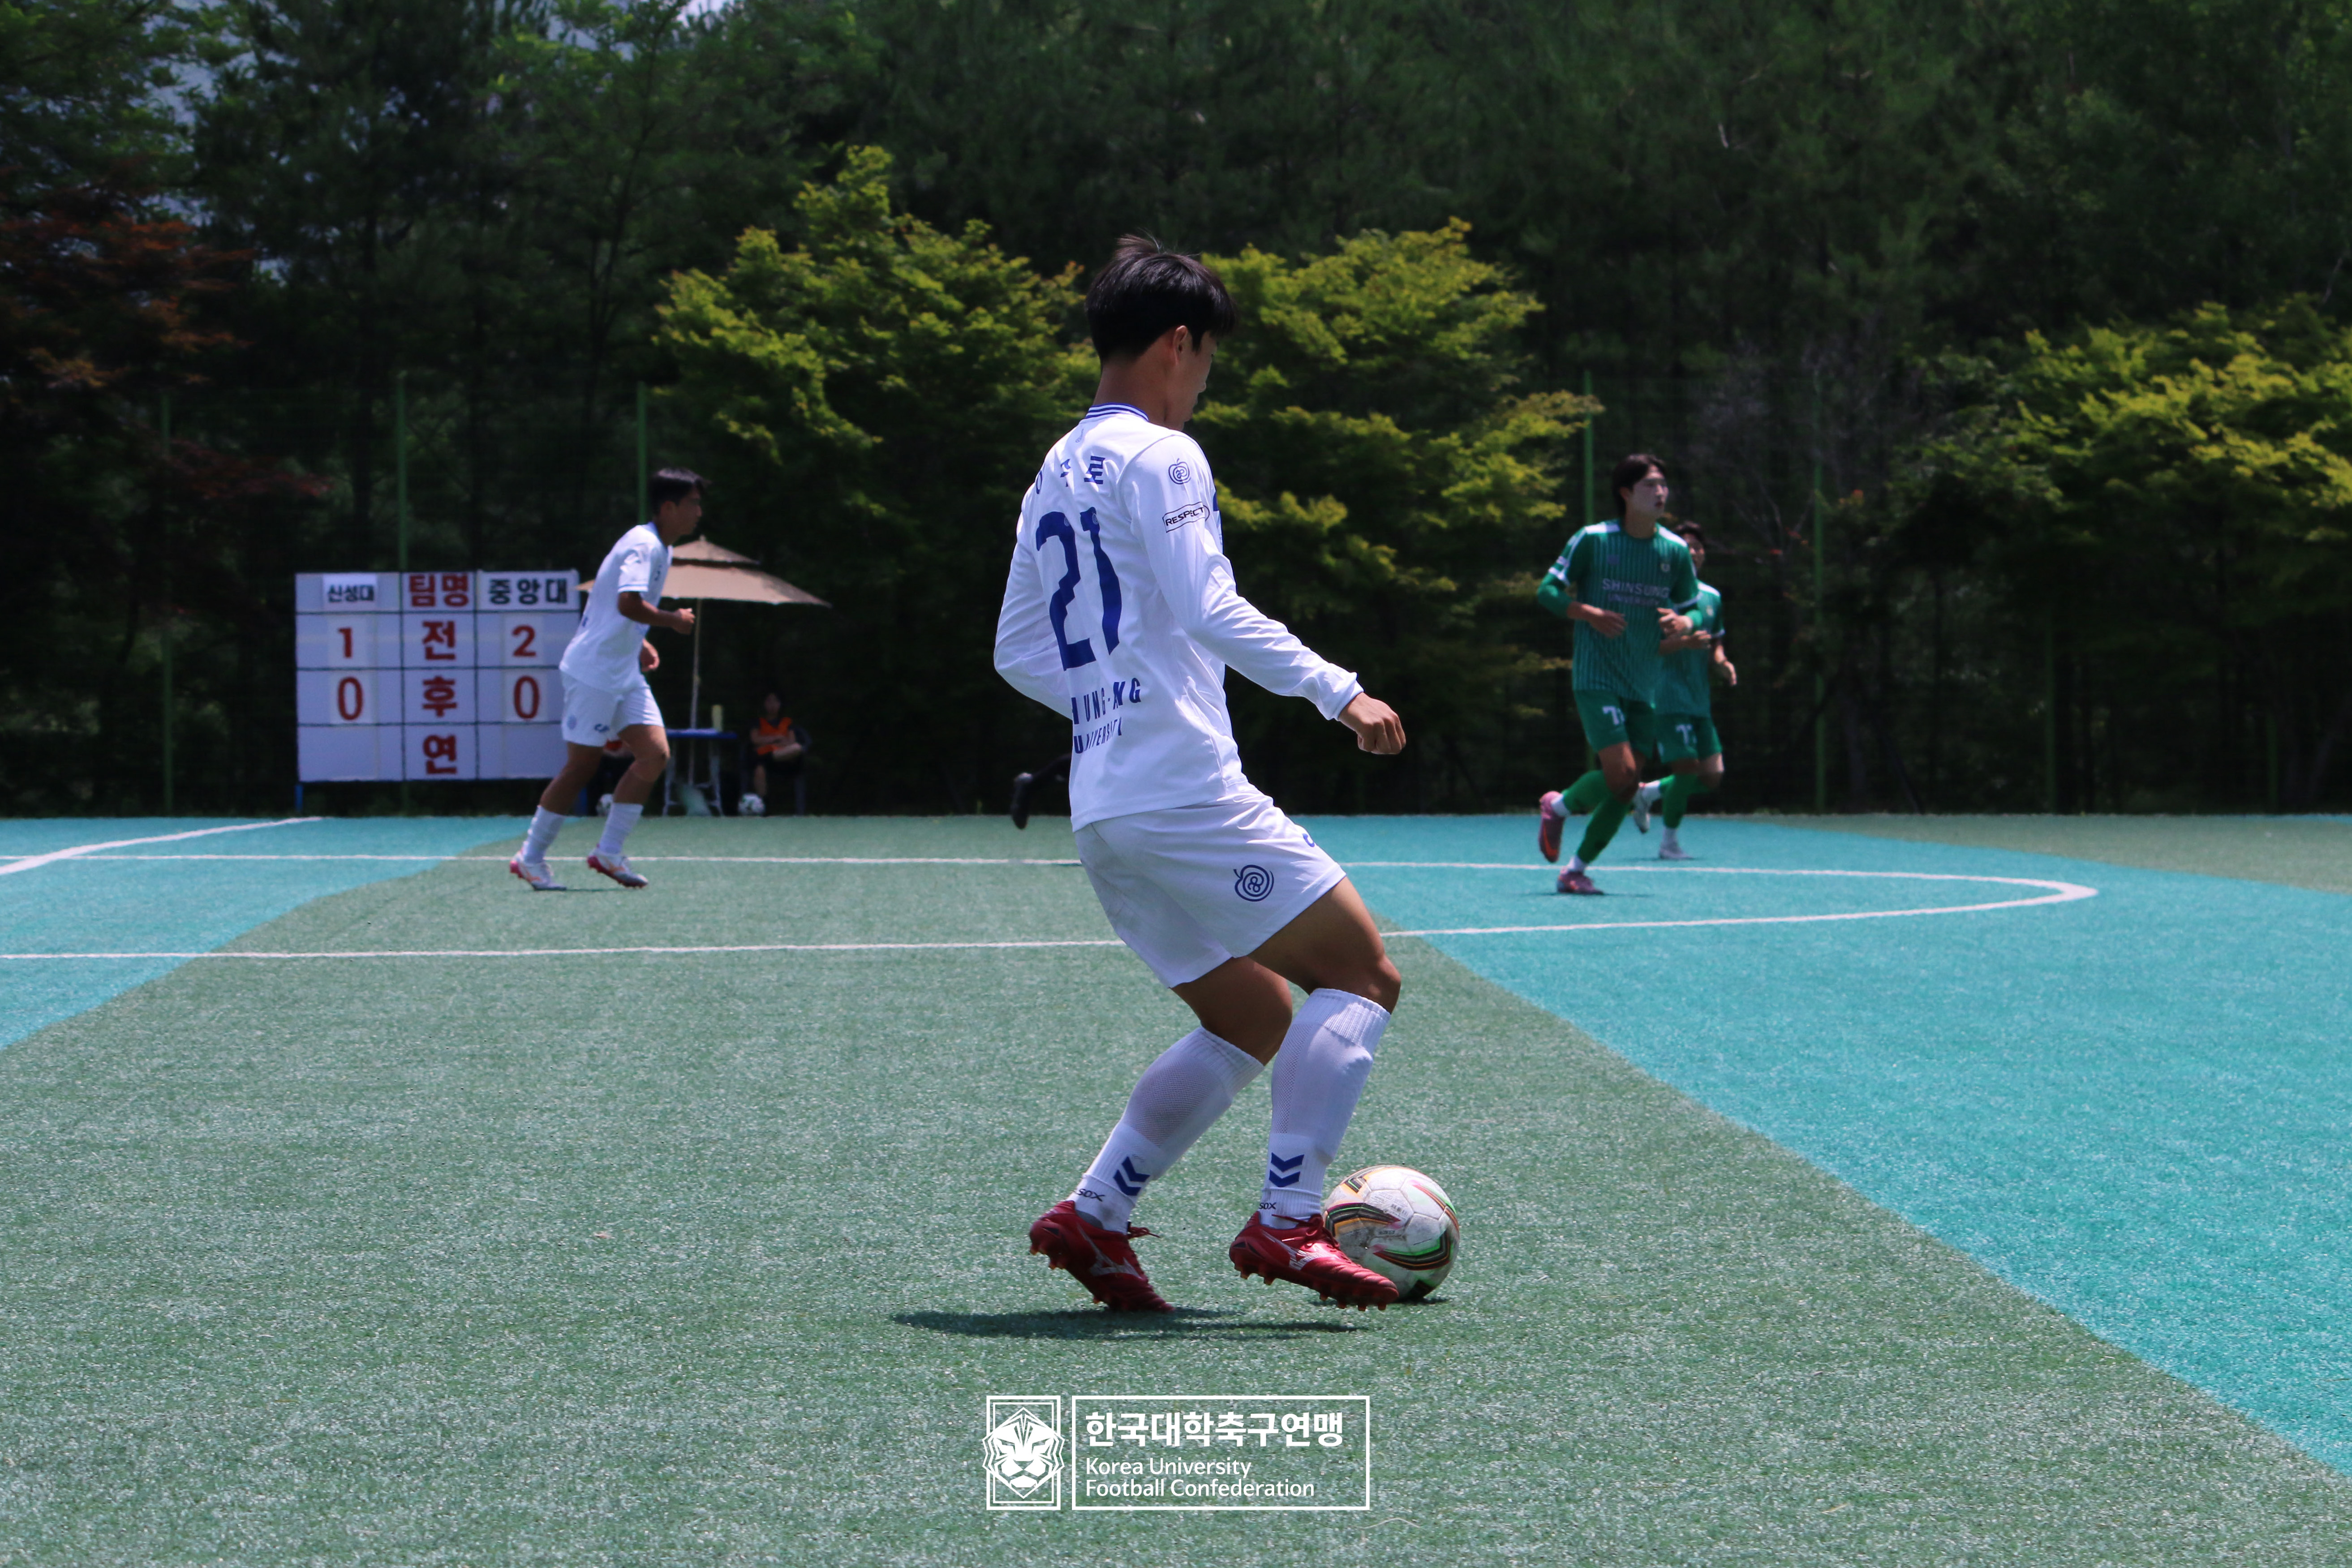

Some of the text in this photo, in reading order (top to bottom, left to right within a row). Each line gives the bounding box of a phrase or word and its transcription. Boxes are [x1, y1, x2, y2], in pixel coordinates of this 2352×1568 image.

[1165, 507, 1204, 526] RESPECT
[327, 574, 568, 607] 신성대 팀명 중앙대
[1036, 507, 1122, 671] 21
[337, 621, 537, 661] 1 전 2
[338, 676, 540, 721] 0 후 0
[422, 735, 457, 775] 연
